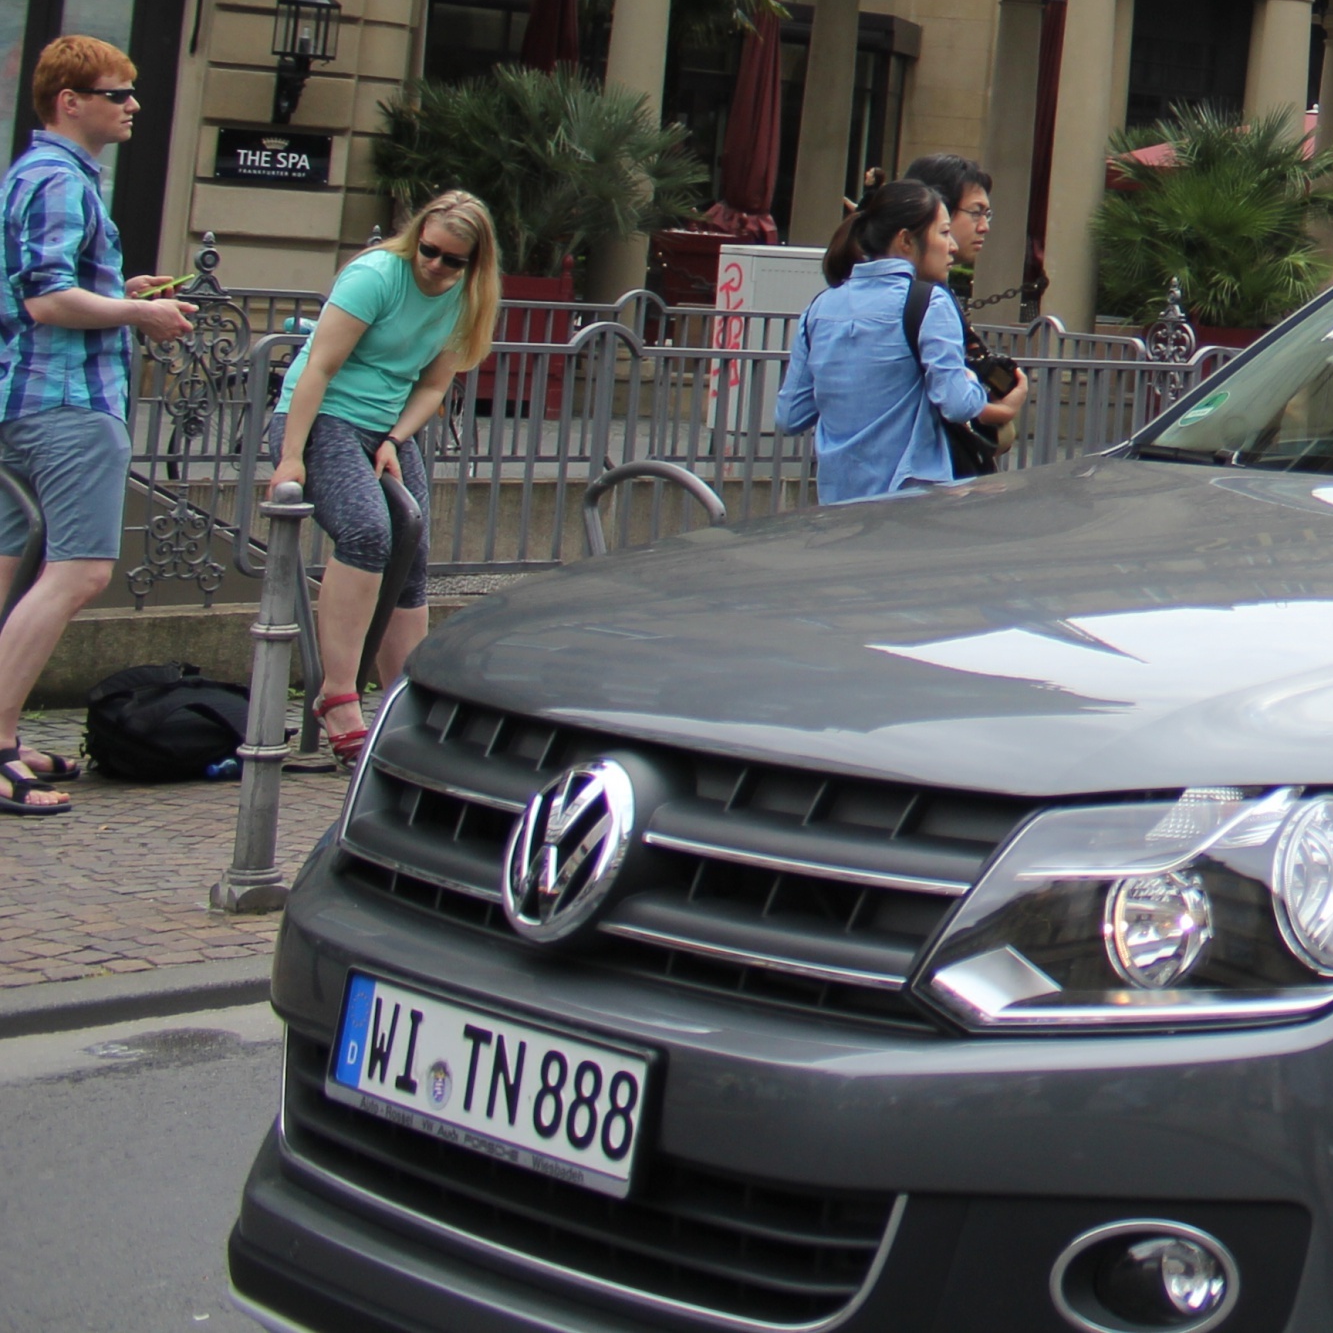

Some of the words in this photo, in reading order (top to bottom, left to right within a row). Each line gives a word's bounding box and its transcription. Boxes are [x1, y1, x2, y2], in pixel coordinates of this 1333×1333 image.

[237, 149, 272, 167] THE
[276, 152, 310, 170] SPA
[238, 168, 289, 177] FRANKFURTER
[346, 1040, 358, 1066] D
[368, 996, 424, 1096] WI
